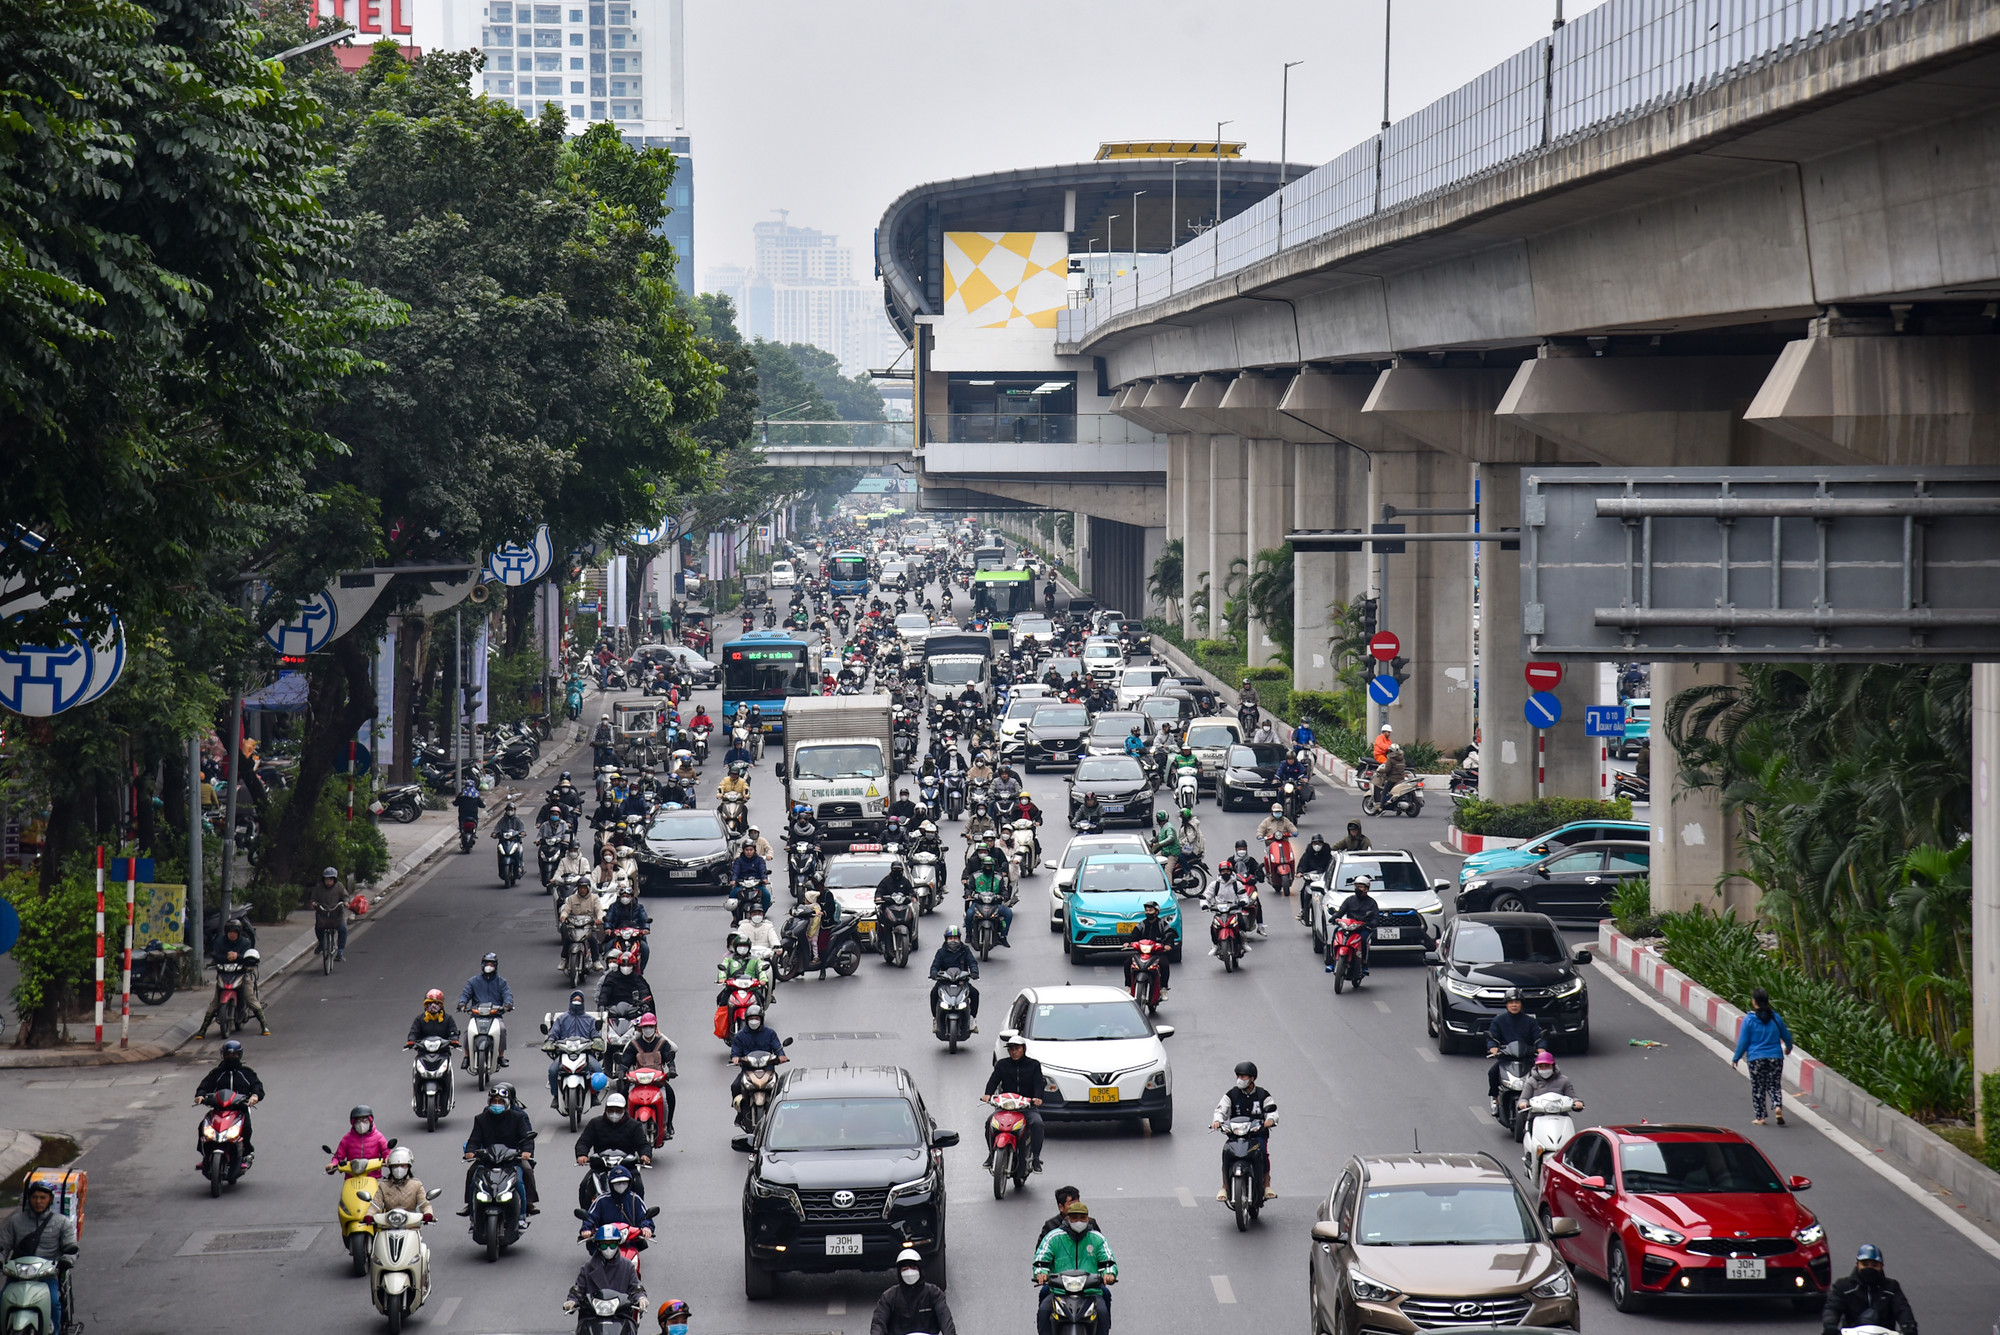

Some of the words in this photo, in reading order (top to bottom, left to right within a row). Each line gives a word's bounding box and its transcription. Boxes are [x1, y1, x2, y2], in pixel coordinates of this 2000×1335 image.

[732, 652, 742, 660] 02
[1251, 1101, 1262, 1115] A
[836, 1237, 852, 1245] 30H
[830, 1245, 859, 1253] 701.92
[1738, 1260, 1754, 1268] 30H
